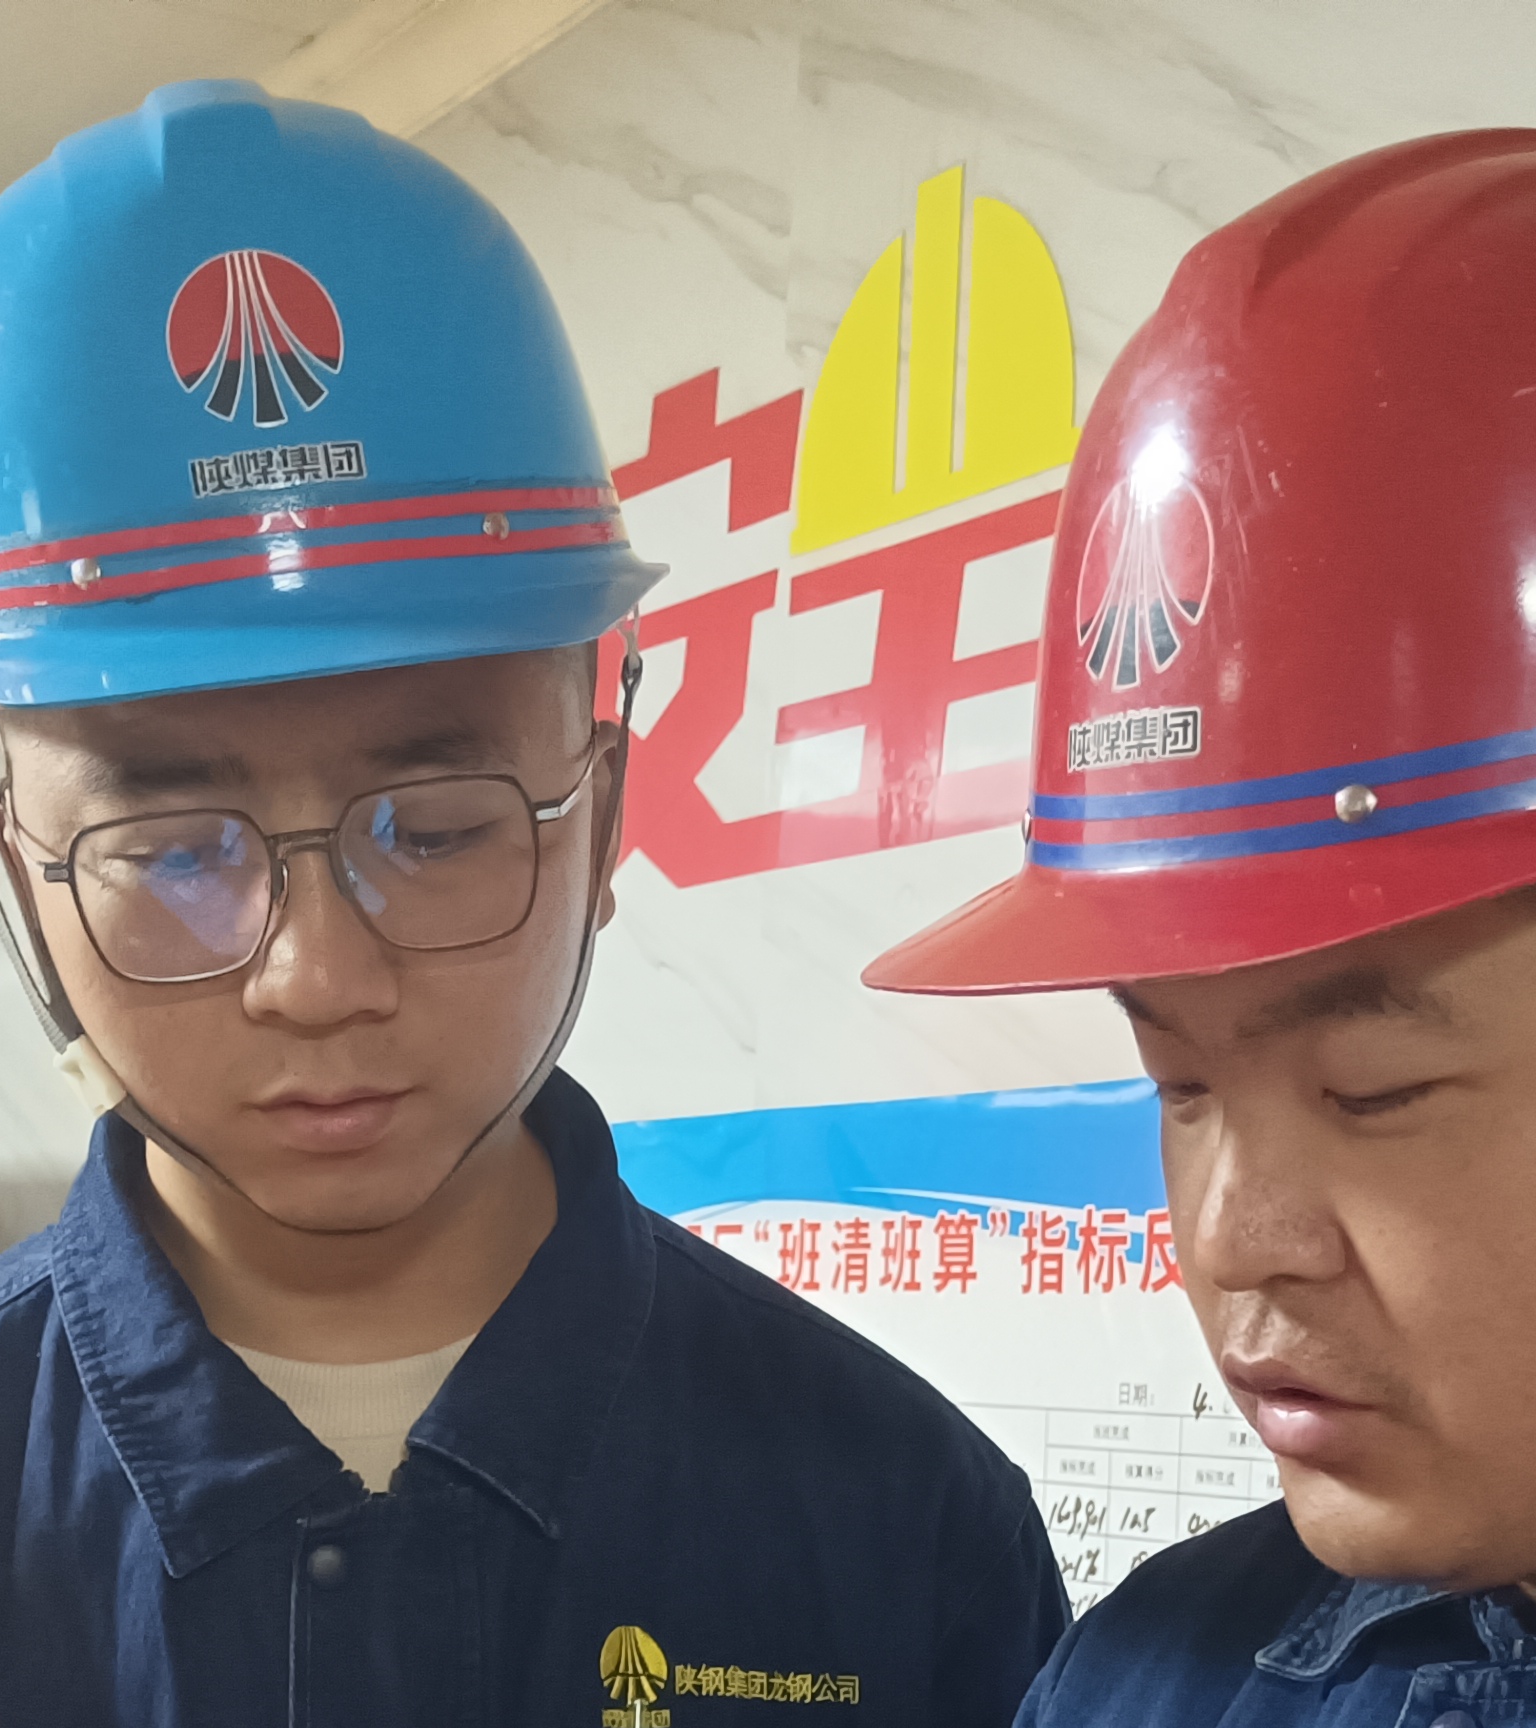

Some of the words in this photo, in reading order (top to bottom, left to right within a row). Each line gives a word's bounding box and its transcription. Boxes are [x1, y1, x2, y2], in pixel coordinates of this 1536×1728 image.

[191, 443, 365, 496] 陕煤集团
[1068, 708, 1200, 770] 陕煤集团
[674, 1663, 860, 1705] 陕钢集团龙钢公司
